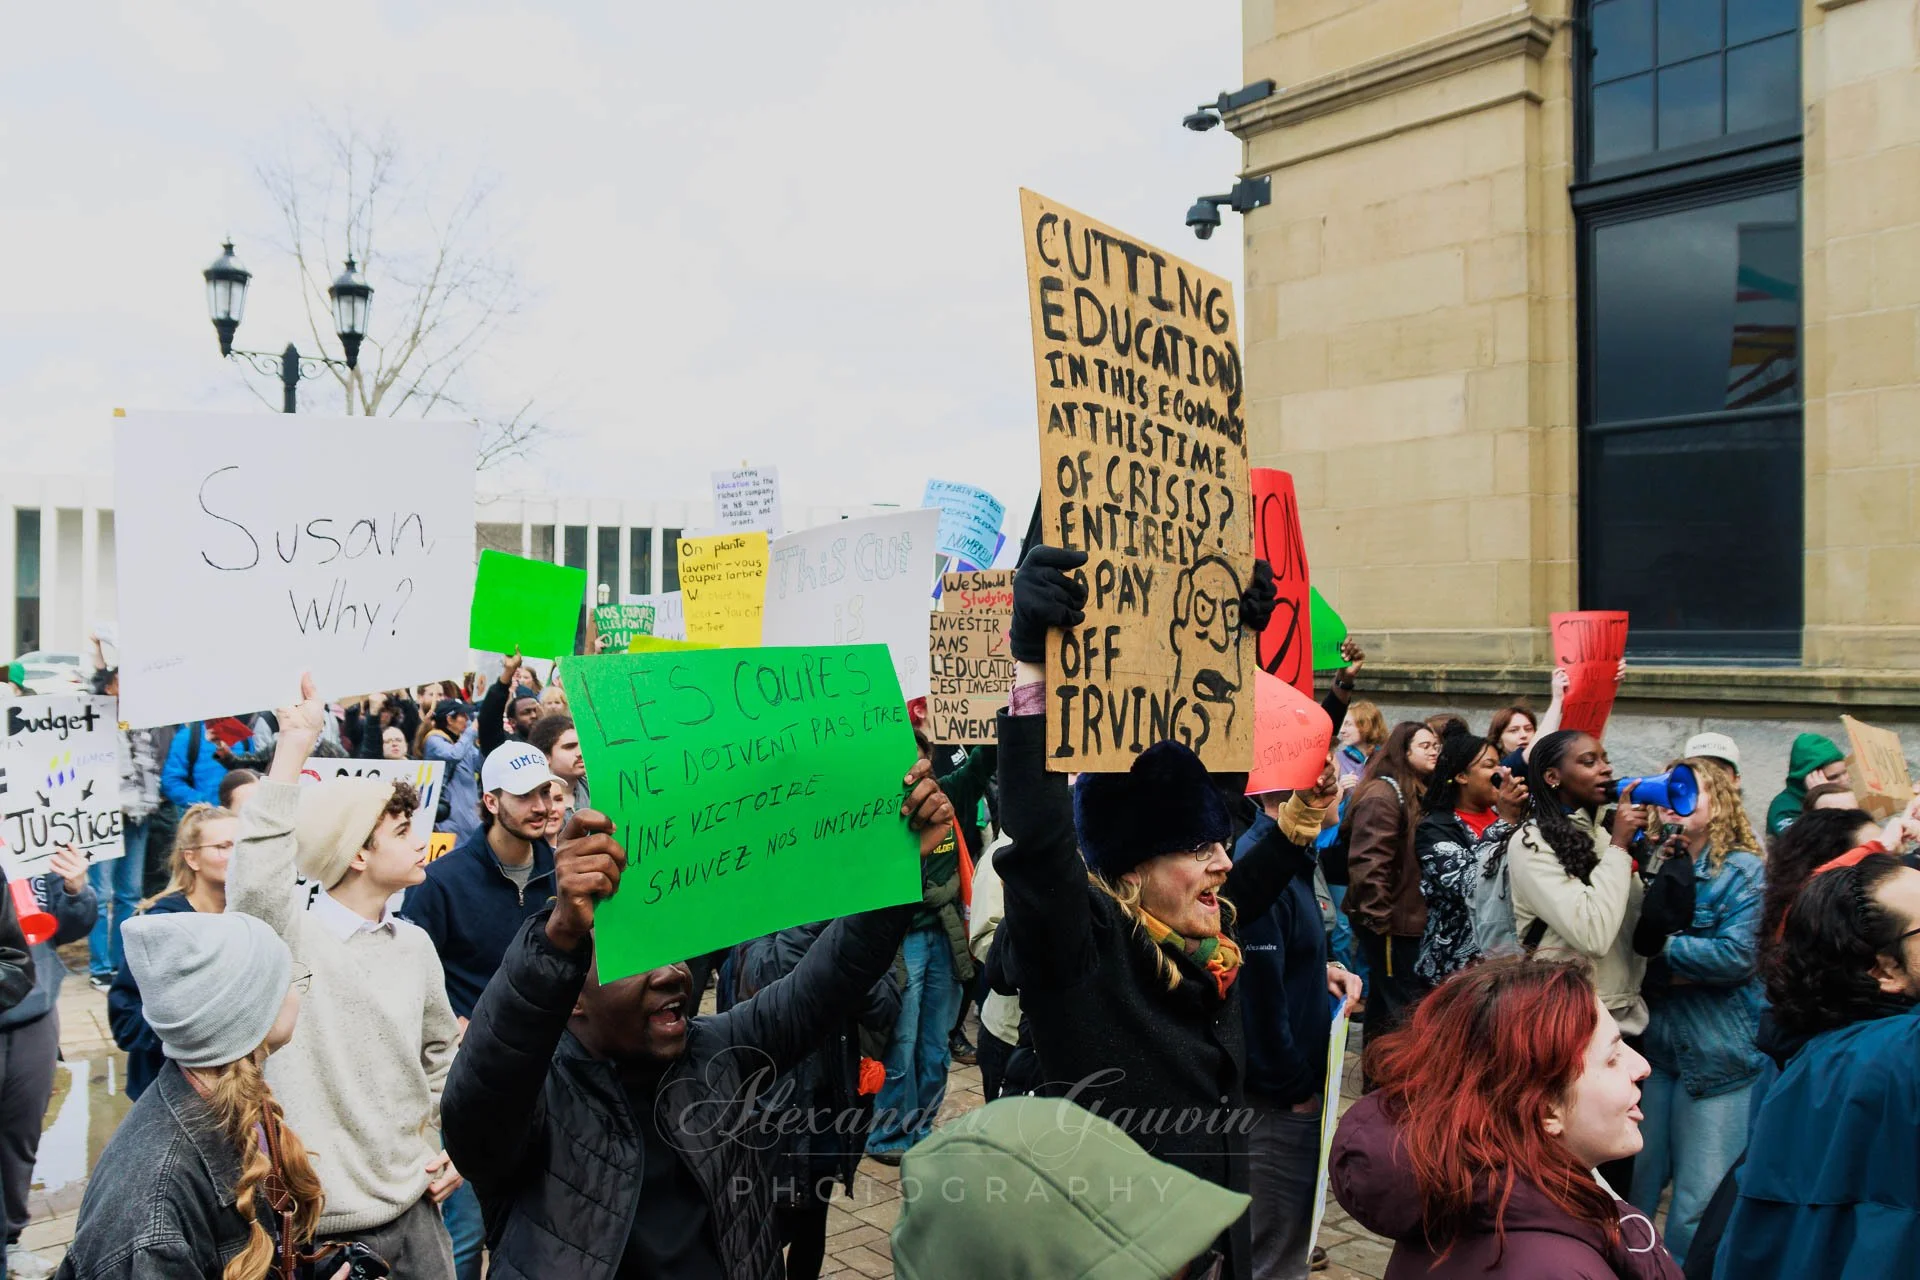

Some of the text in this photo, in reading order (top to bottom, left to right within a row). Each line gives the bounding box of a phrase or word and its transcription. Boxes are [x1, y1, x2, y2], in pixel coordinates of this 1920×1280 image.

[1036, 212, 1230, 336] CUTTING
[1045, 350, 1089, 389] IN
[1093, 358, 1149, 410] THIS
[1047, 401, 1227, 480] AT THIS TIME
[198, 465, 436, 571] Susan,
[1057, 450, 1235, 549] OF CRISIS?
[682, 542, 703, 557] On
[1059, 501, 1205, 566] ENTIRELY
[682, 573, 722, 585] coupez
[734, 559, 762, 568] vous
[943, 574, 970, 593] We
[972, 571, 1006, 592] Should
[960, 590, 1013, 609] Studying
[1095, 558, 1154, 617] PAY
[289, 577, 413, 653] Why?
[595, 606, 619, 620] VOS
[930, 614, 1000, 634] INVESTIR
[930, 635, 969, 653] DANS
[931, 653, 1016, 679] L'ÉDUCATIO
[1060, 625, 1121, 681] OFF
[7, 703, 101, 741] Budget
[580, 664, 716, 748] LES
[733, 652, 872, 722] COUPES
[934, 698, 970, 715] DANS
[1055, 684, 1210, 758] IRVING?
[683, 723, 800, 785] DOIVENT
[811, 715, 855, 746] PAS
[933, 714, 998, 741] L'AVENI
[510, 754, 545, 770] UMCS
[625, 773, 826, 868] UNE VICTOIRE
[643, 844, 752, 905] SAUVEZ
[767, 826, 798, 859] NOS
[1245, 943, 1278, 951] Alexandre
